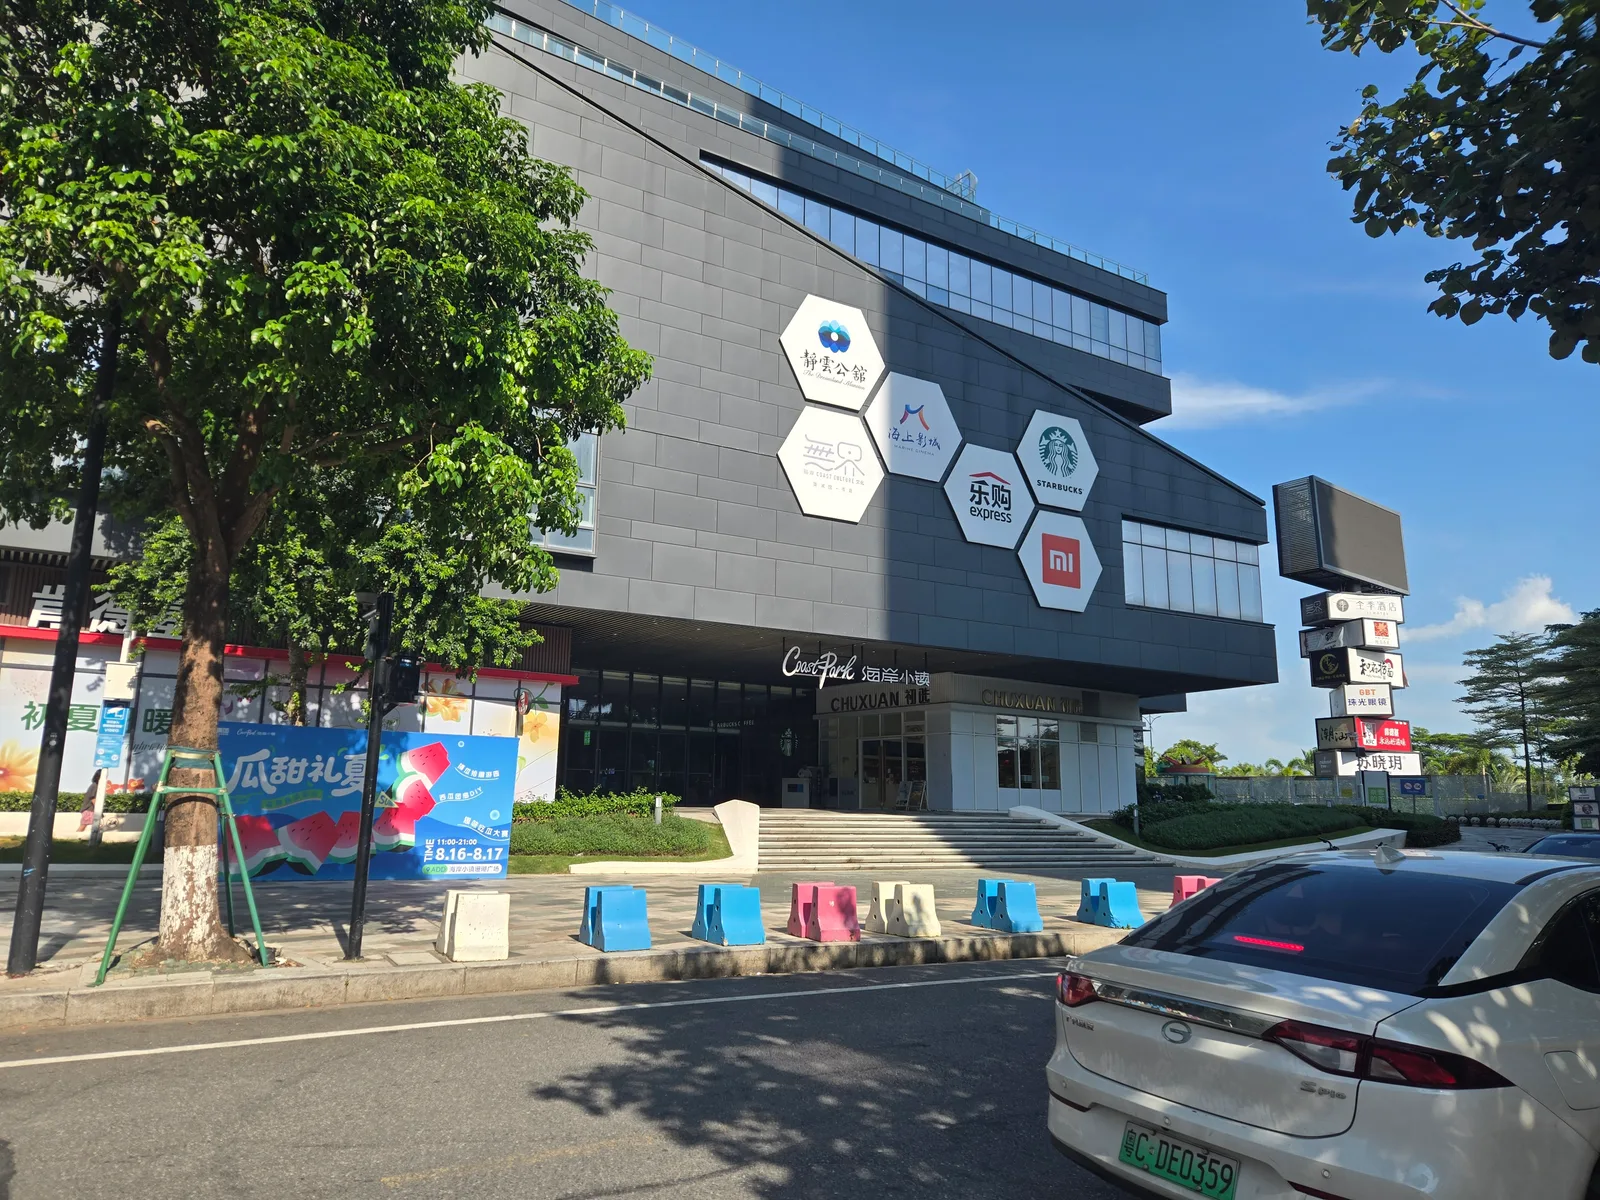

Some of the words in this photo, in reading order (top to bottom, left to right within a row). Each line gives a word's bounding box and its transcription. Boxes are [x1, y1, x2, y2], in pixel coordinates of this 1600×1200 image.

[888, 427, 941, 451] 海上影城
[969, 480, 1012, 512] 乐购
[1037, 479, 1083, 495] STARBUCKS
[970, 505, 1012, 524] express
[862, 665, 930, 687] 海岸小镇
[831, 692, 899, 712] CHUXUAN
[982, 689, 1055, 711] CHUXUAN
[226, 749, 367, 797] 瓜甜礼夏
[424, 839, 435, 862] TIME
[435, 848, 503, 860] 8.16-8.17
